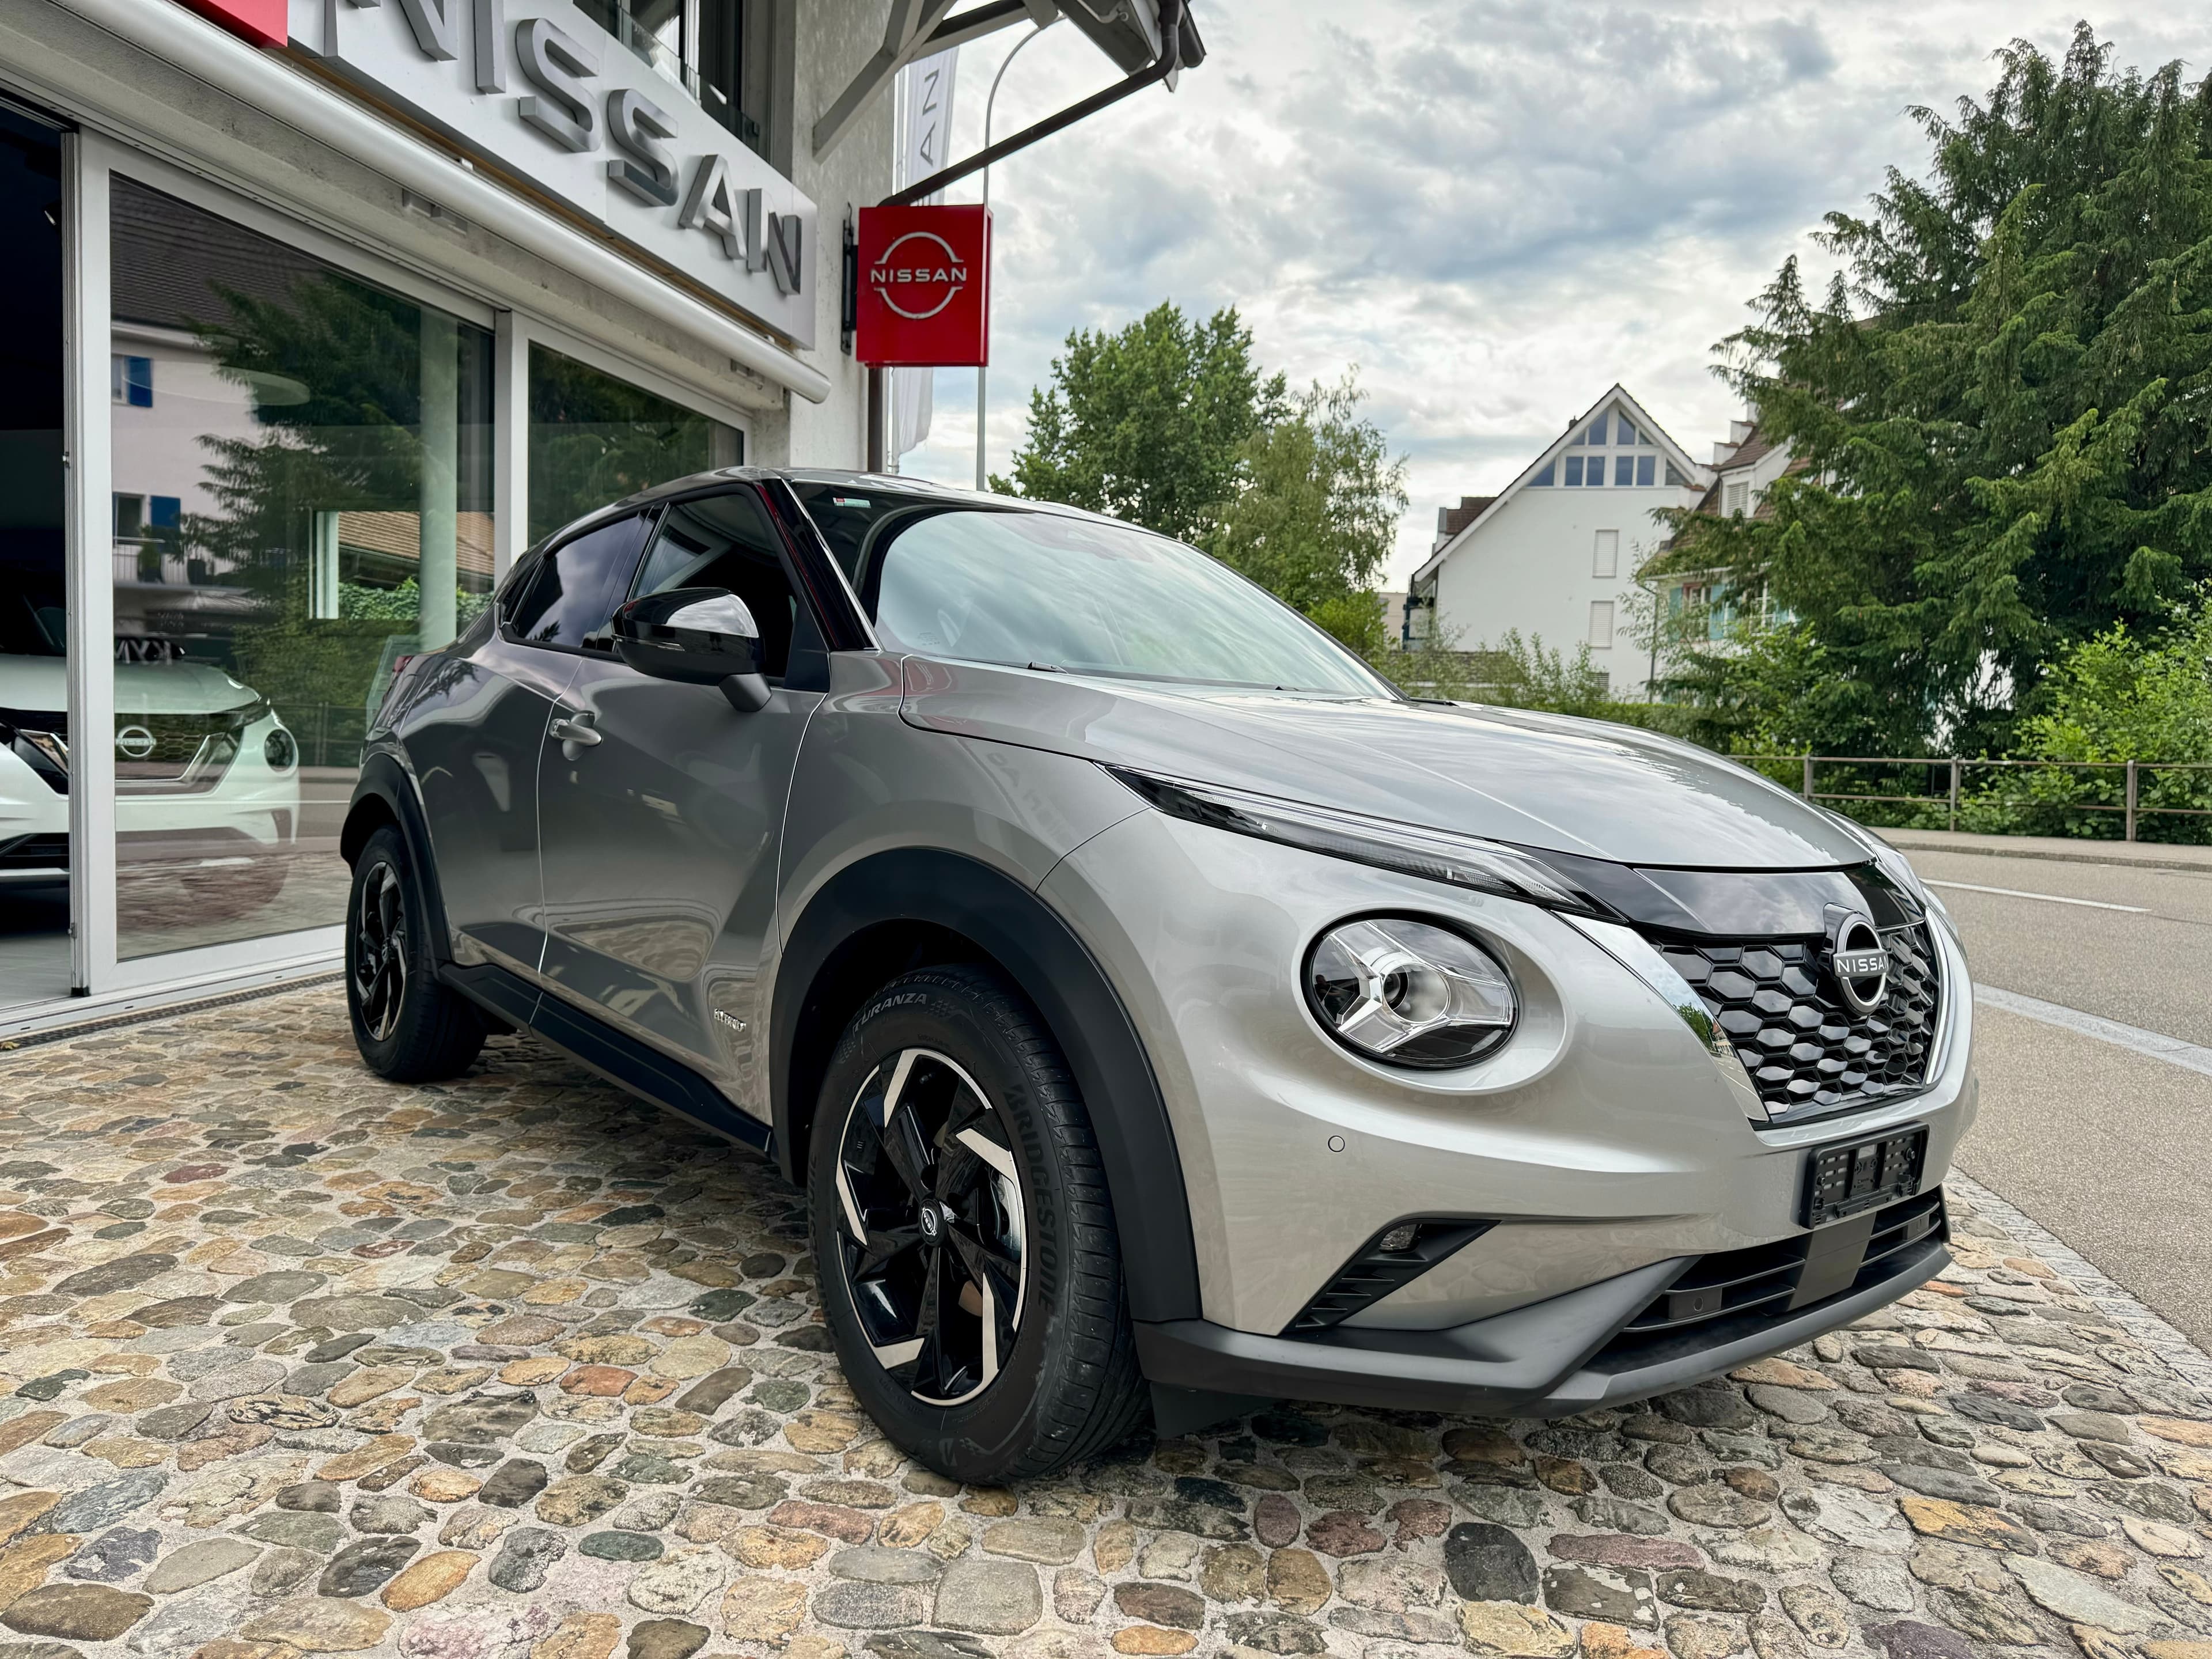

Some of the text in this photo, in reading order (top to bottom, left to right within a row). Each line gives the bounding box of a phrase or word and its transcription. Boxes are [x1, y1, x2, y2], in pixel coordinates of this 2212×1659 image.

[870, 267, 967, 283] NISSAN
[1836, 955, 1889, 973] NISSAN
[853, 993, 927, 1037] TURANZA
[1003, 1084, 1058, 1313] BRIDGESTONE
